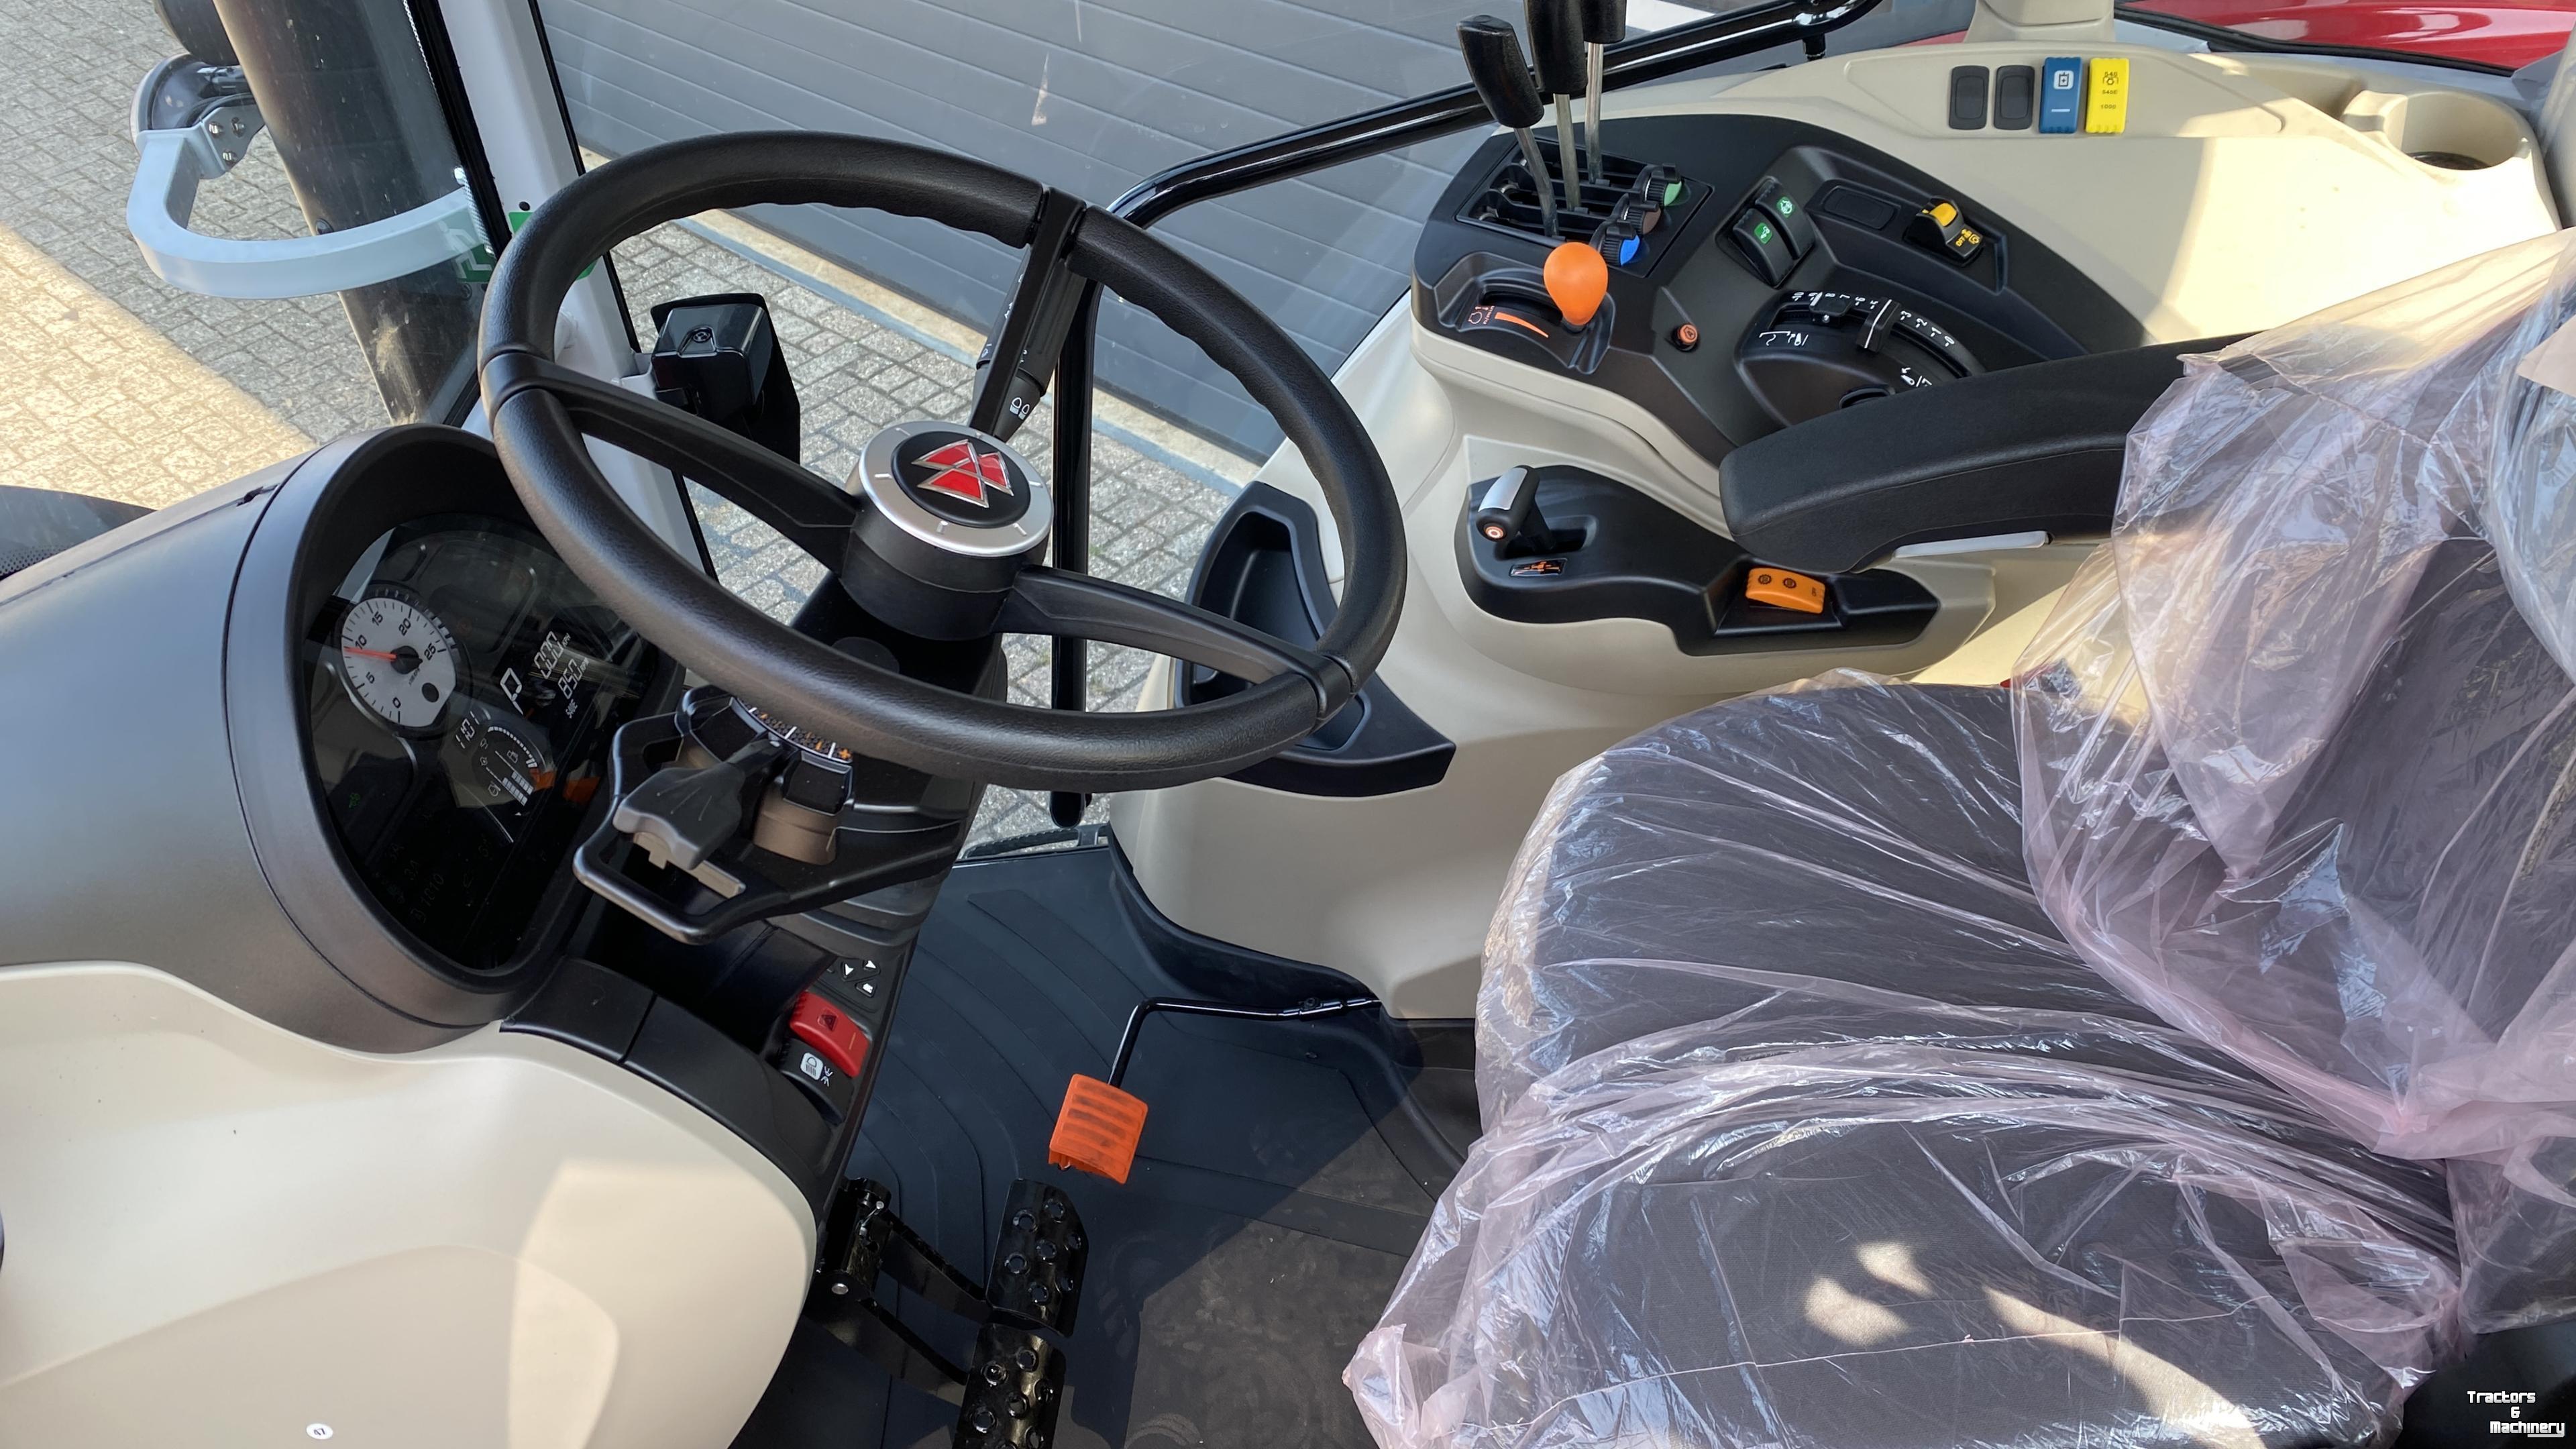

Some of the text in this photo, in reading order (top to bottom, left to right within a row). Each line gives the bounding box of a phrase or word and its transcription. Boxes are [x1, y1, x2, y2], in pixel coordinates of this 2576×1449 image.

[1900, 310, 1911, 318] 3
[1916, 318, 1927, 326] 2
[1931, 327, 1941, 335] 1
[1944, 335, 1955, 344] 0
[372, 611, 383, 626] 15
[398, 618, 411, 636] 20
[355, 634, 367, 649] 10
[424, 643, 436, 661] 25
[366, 672, 375, 684] 5
[557, 659, 582, 699] 850
[392, 697, 401, 708] 0
[313, 1428, 326, 1436] 47
